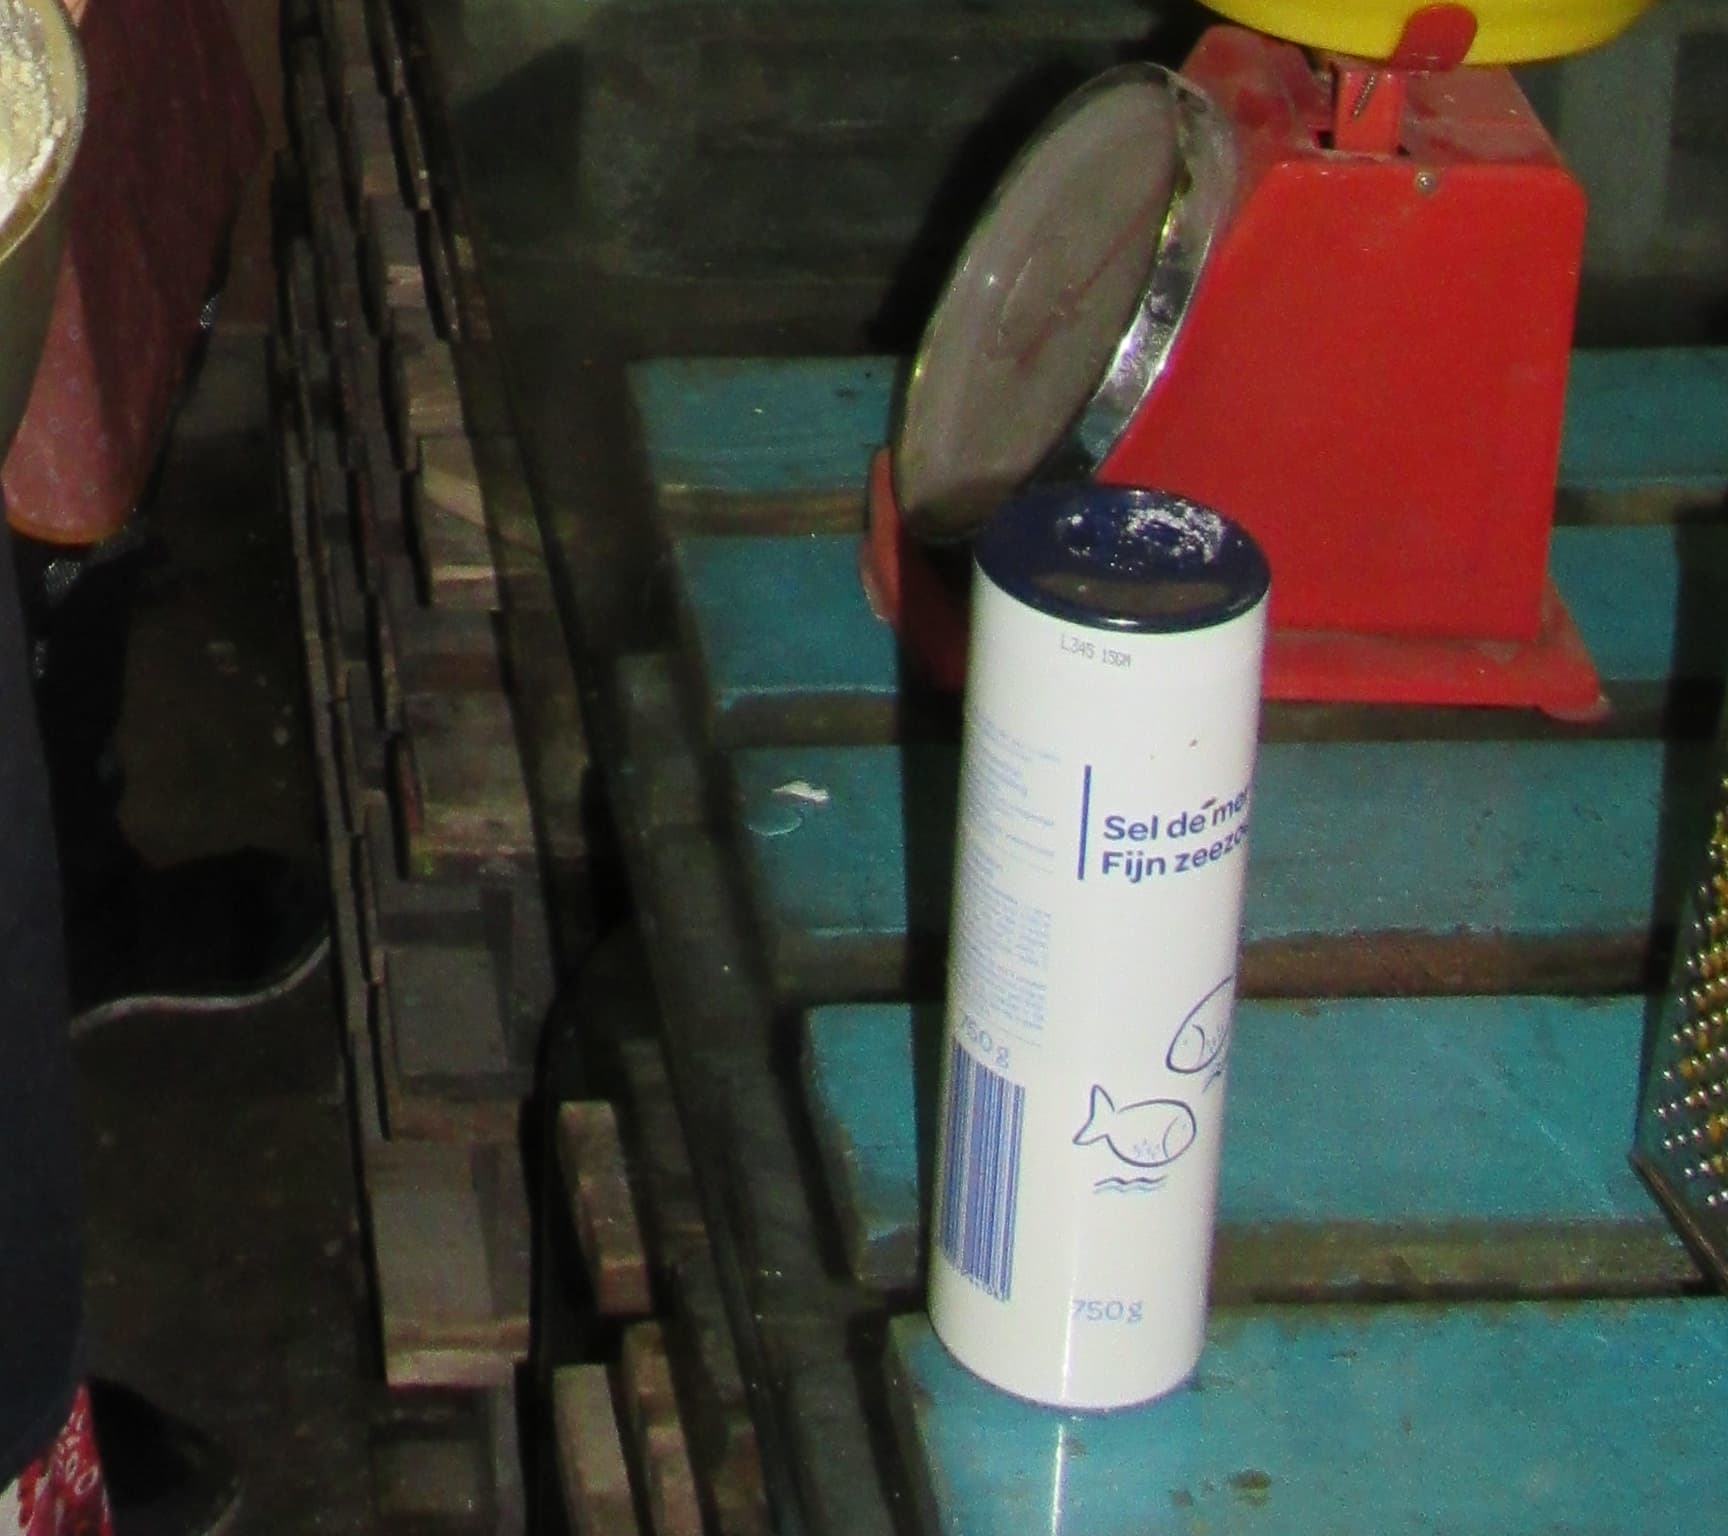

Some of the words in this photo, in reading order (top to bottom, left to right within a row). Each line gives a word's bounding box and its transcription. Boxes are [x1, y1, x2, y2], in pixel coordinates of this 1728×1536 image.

[1103, 814, 1159, 841] Sel
[1101, 848, 1167, 884] Fijn
[1070, 1299, 1125, 1321] 750
